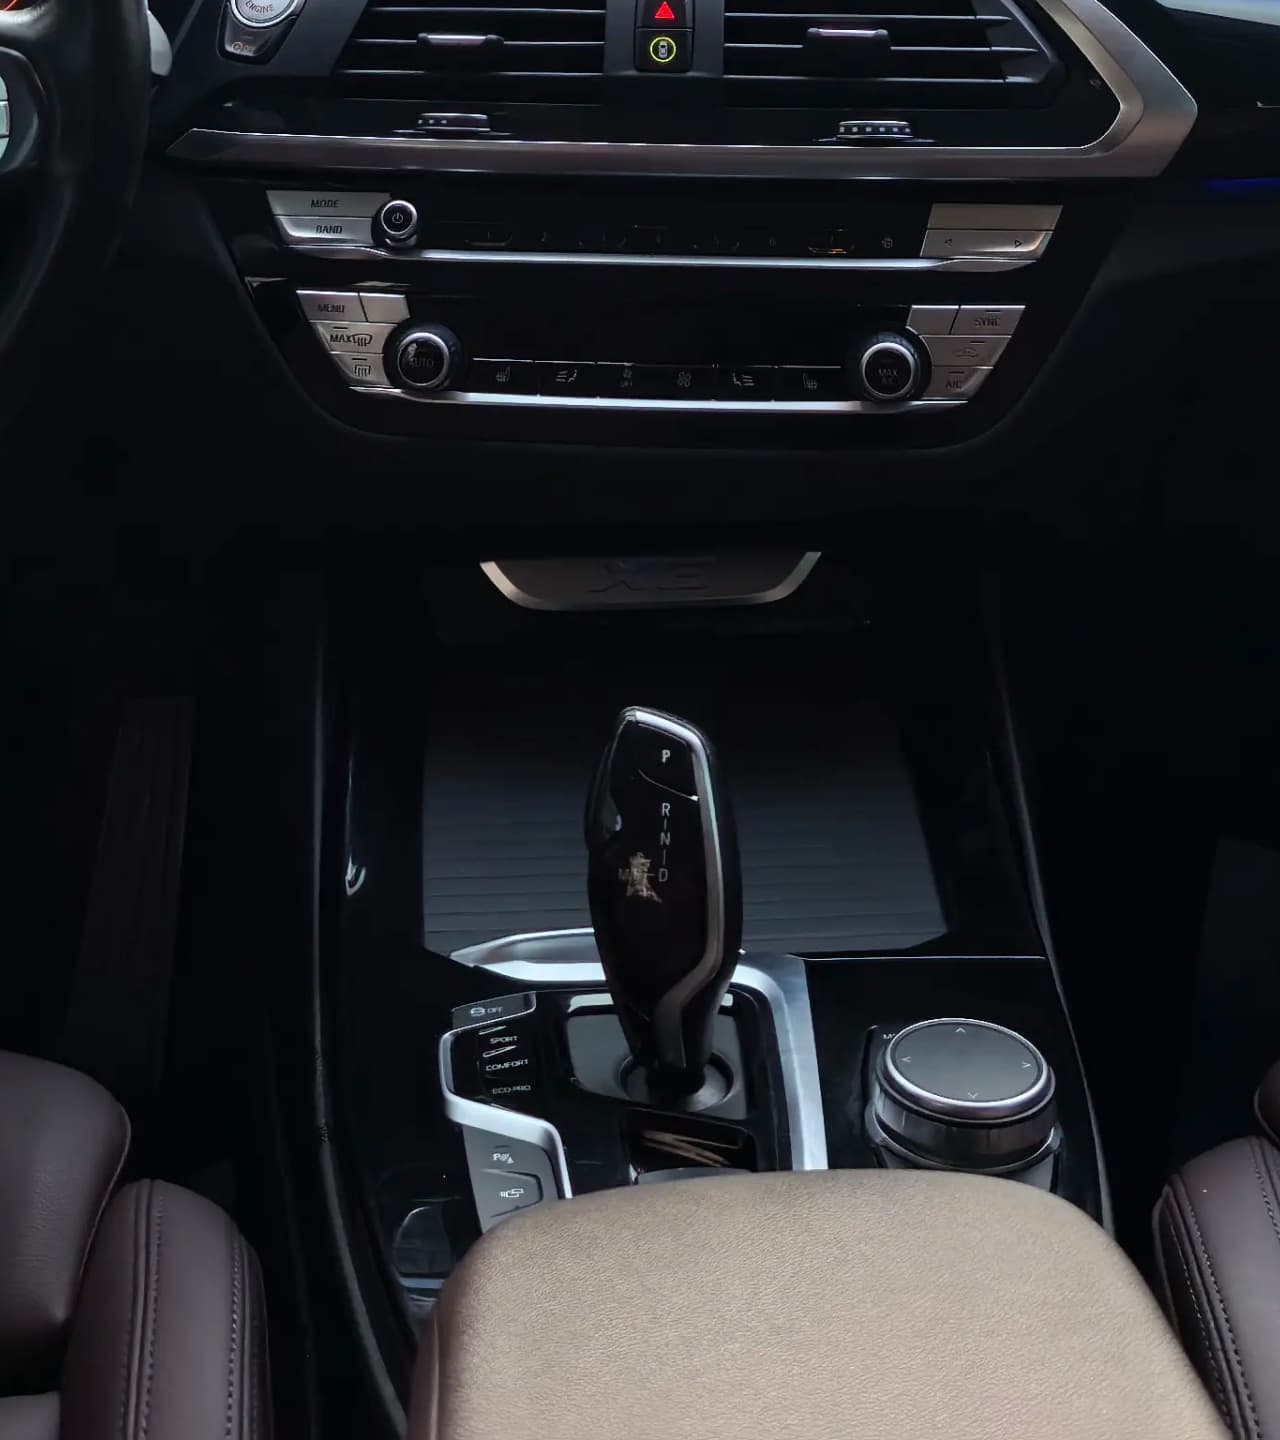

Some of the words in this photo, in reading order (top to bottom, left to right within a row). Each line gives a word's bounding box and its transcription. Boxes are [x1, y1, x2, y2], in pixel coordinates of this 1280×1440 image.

[245, 0, 275, 14] ENGINE
[310, 199, 341, 209] MODE
[316, 224, 343, 235] BAND
[317, 304, 345, 313] MENU
[974, 317, 1001, 327] SYNC
[330, 334, 352, 344] MAX
[408, 357, 434, 369] AUTO
[877, 367, 899, 377] MAX
[945, 379, 962, 390] A/C
[661, 749, 671, 763] P
[661, 802, 671, 817] R
[660, 832, 671, 846] N
[658, 868, 669, 882] D
[487, 1006, 504, 1014] OFF
[490, 1035, 518, 1044] SPORT
[485, 1058, 529, 1071] COMFORT
[492, 1086, 512, 1095] ECO
